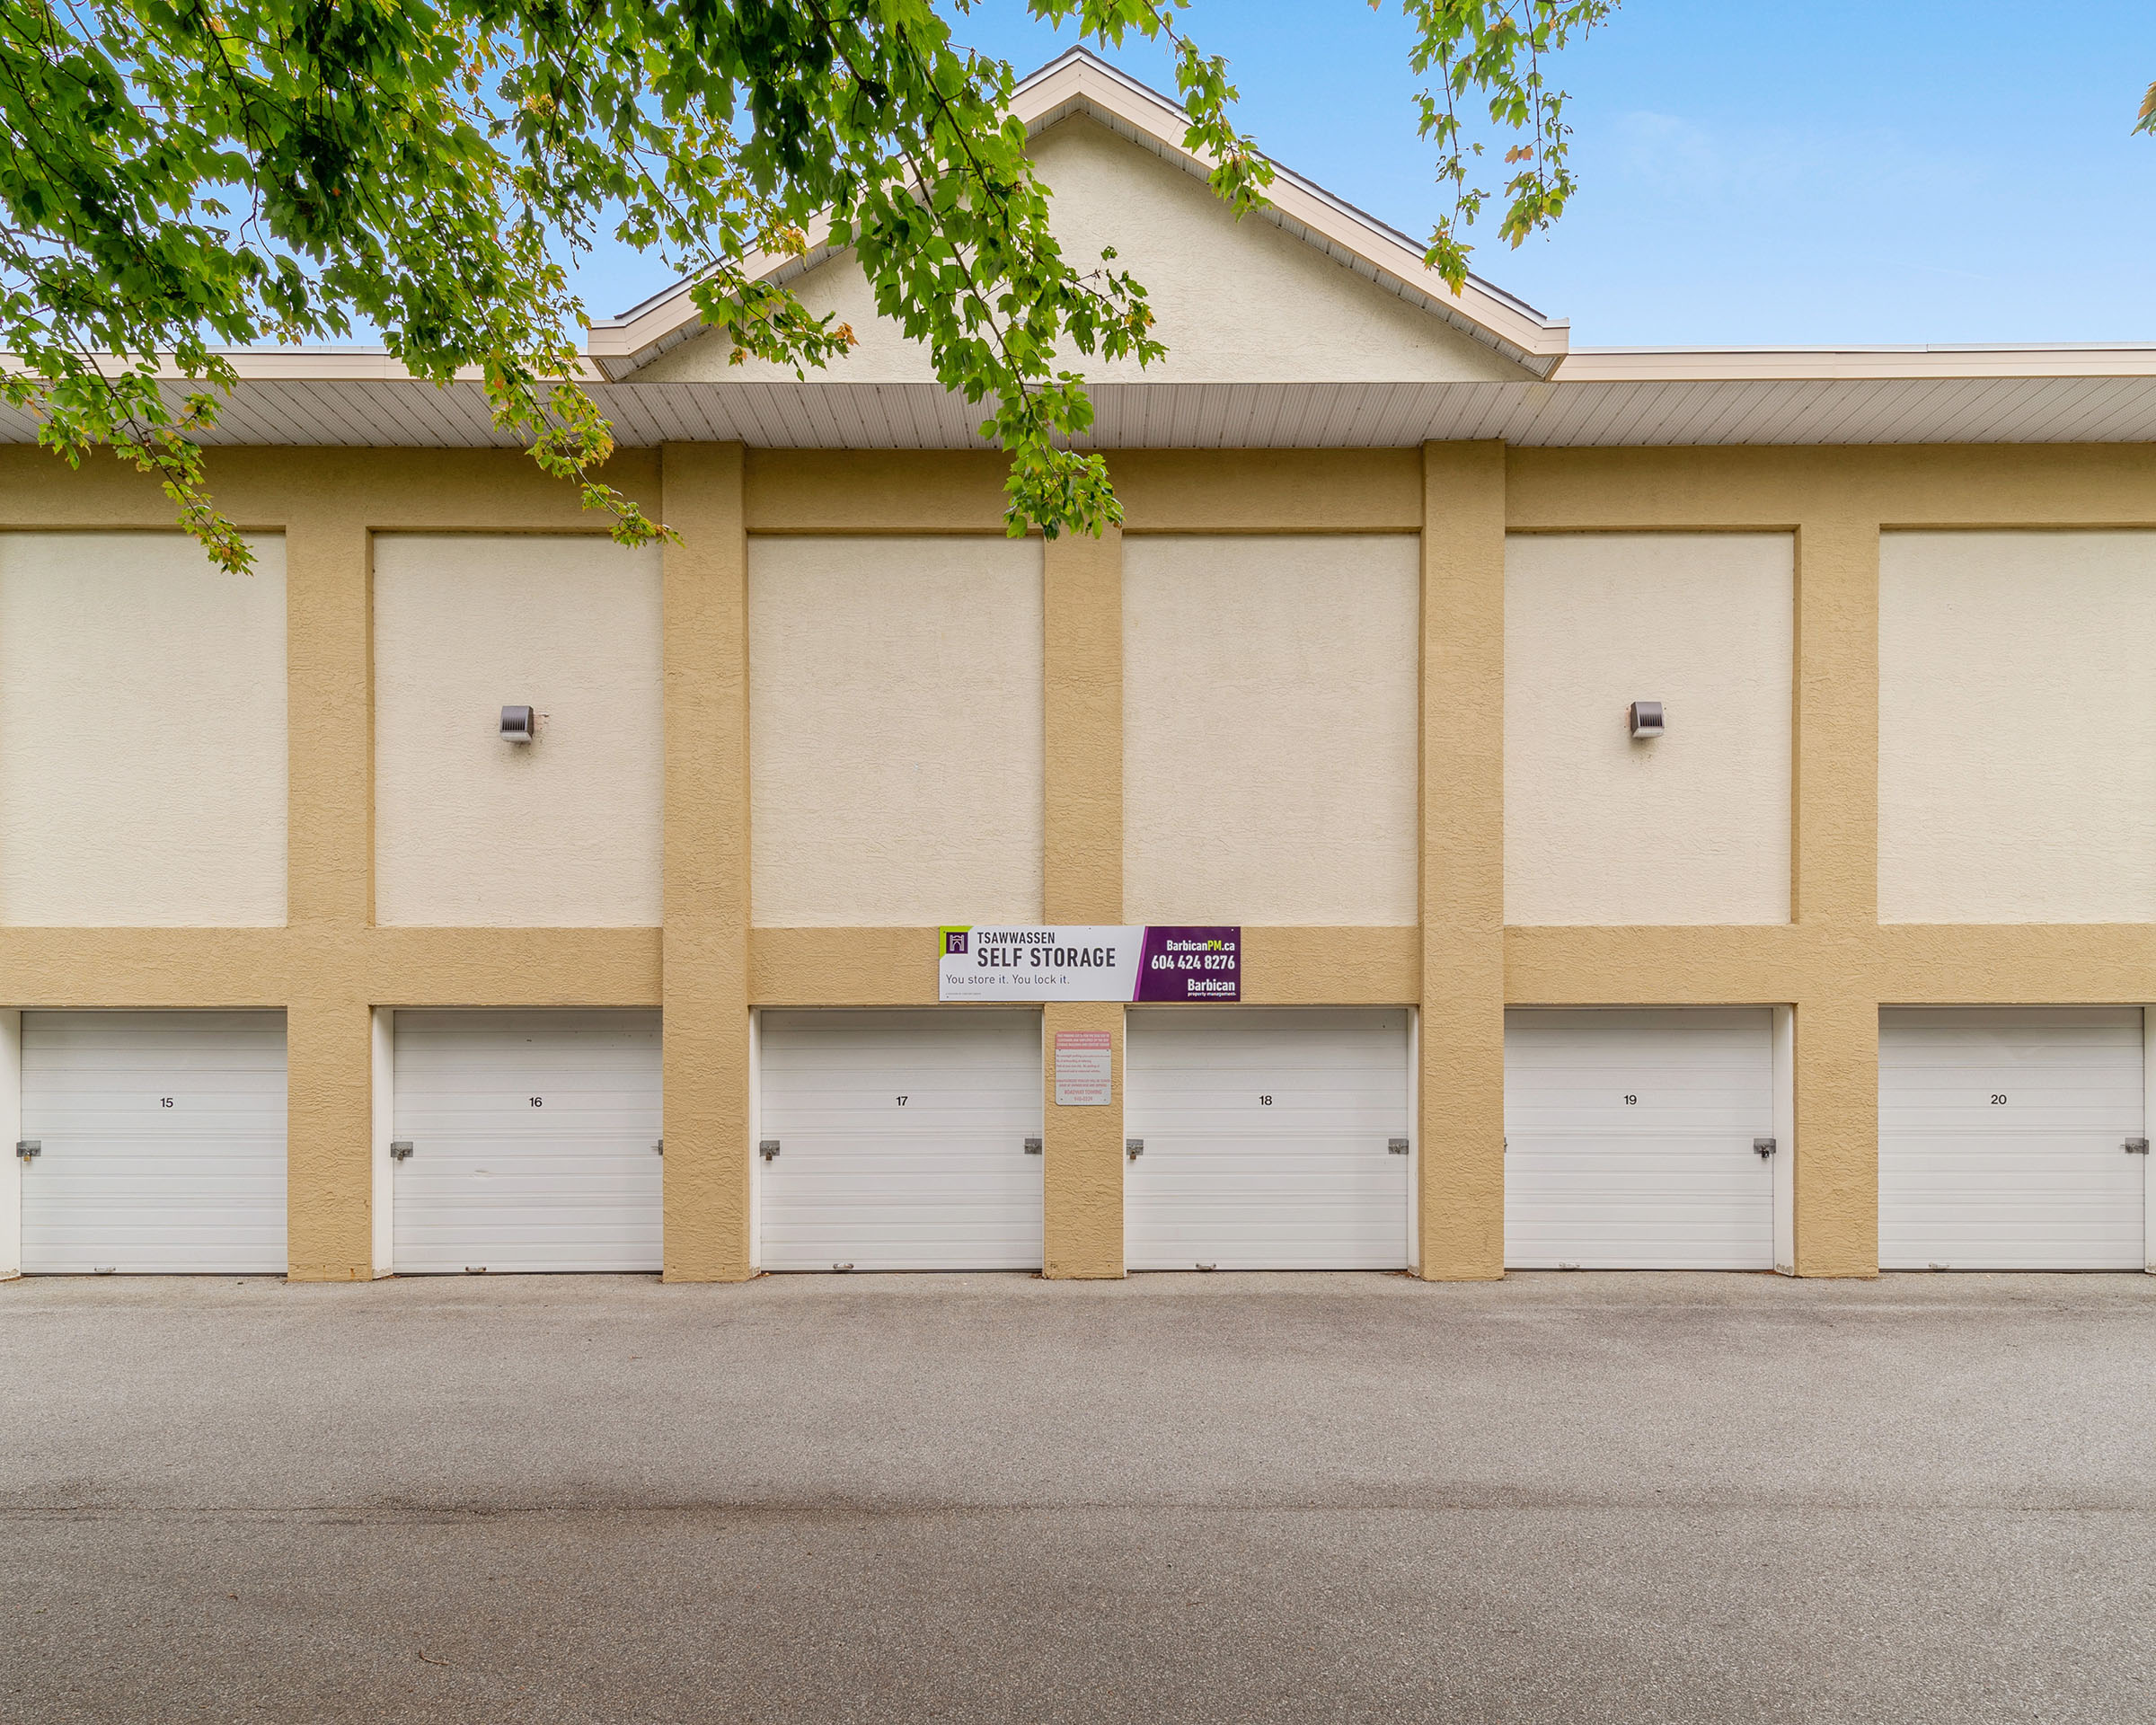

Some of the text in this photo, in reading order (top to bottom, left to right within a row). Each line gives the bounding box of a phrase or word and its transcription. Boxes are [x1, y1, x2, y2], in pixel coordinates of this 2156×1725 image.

[977, 932, 1055, 944] TSAWWASSEN
[1166, 940, 1235, 951] BarbicanPM.ca
[977, 947, 1116, 968] SELF STORAGE
[1151, 955, 1235, 969] 604 424 8276
[946, 974, 1070, 985] You store it. You lock it.
[1187, 978, 1235, 992] Barbican
[160, 1097, 173, 1109] 15
[529, 1097, 543, 1108] 16
[896, 1095, 908, 1107] 17
[1259, 1095, 1272, 1106] 18
[1623, 1094, 1637, 1105] 19
[1991, 1094, 2007, 1105] 20
